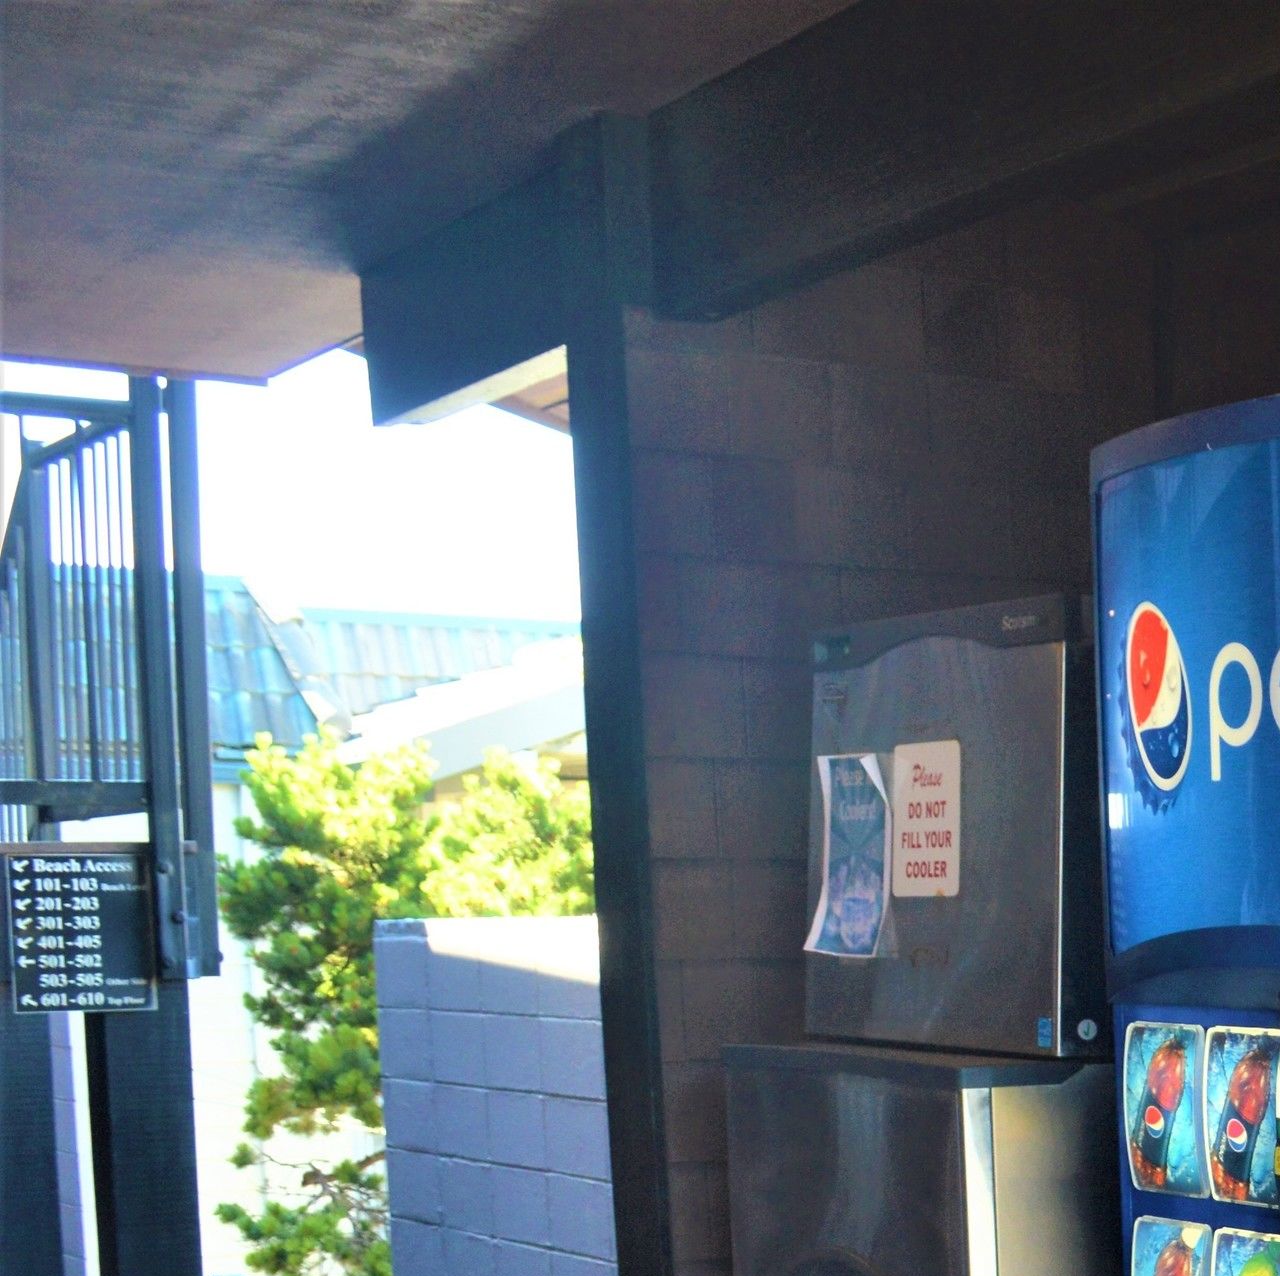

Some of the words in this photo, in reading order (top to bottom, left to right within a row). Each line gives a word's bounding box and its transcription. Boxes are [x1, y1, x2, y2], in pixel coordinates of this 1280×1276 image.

[912, 763, 944, 789] Please
[908, 801, 923, 820] DO
[926, 800, 946, 819] NOT
[901, 832, 922, 850] FILL
[924, 830, 952, 849] YOUR
[32, 858, 81, 873] Beach
[83, 858, 133, 872] Access
[905, 860, 947, 879] COOLER
[34, 877, 98, 892] 101-103
[35, 897, 99, 911] 201-203
[35, 916, 101, 930] 301-303
[37, 935, 102, 949] 401-405
[38, 954, 103, 968] 501-502
[39, 973, 104, 987] 503-505
[40, 992, 105, 1006] 601-610
